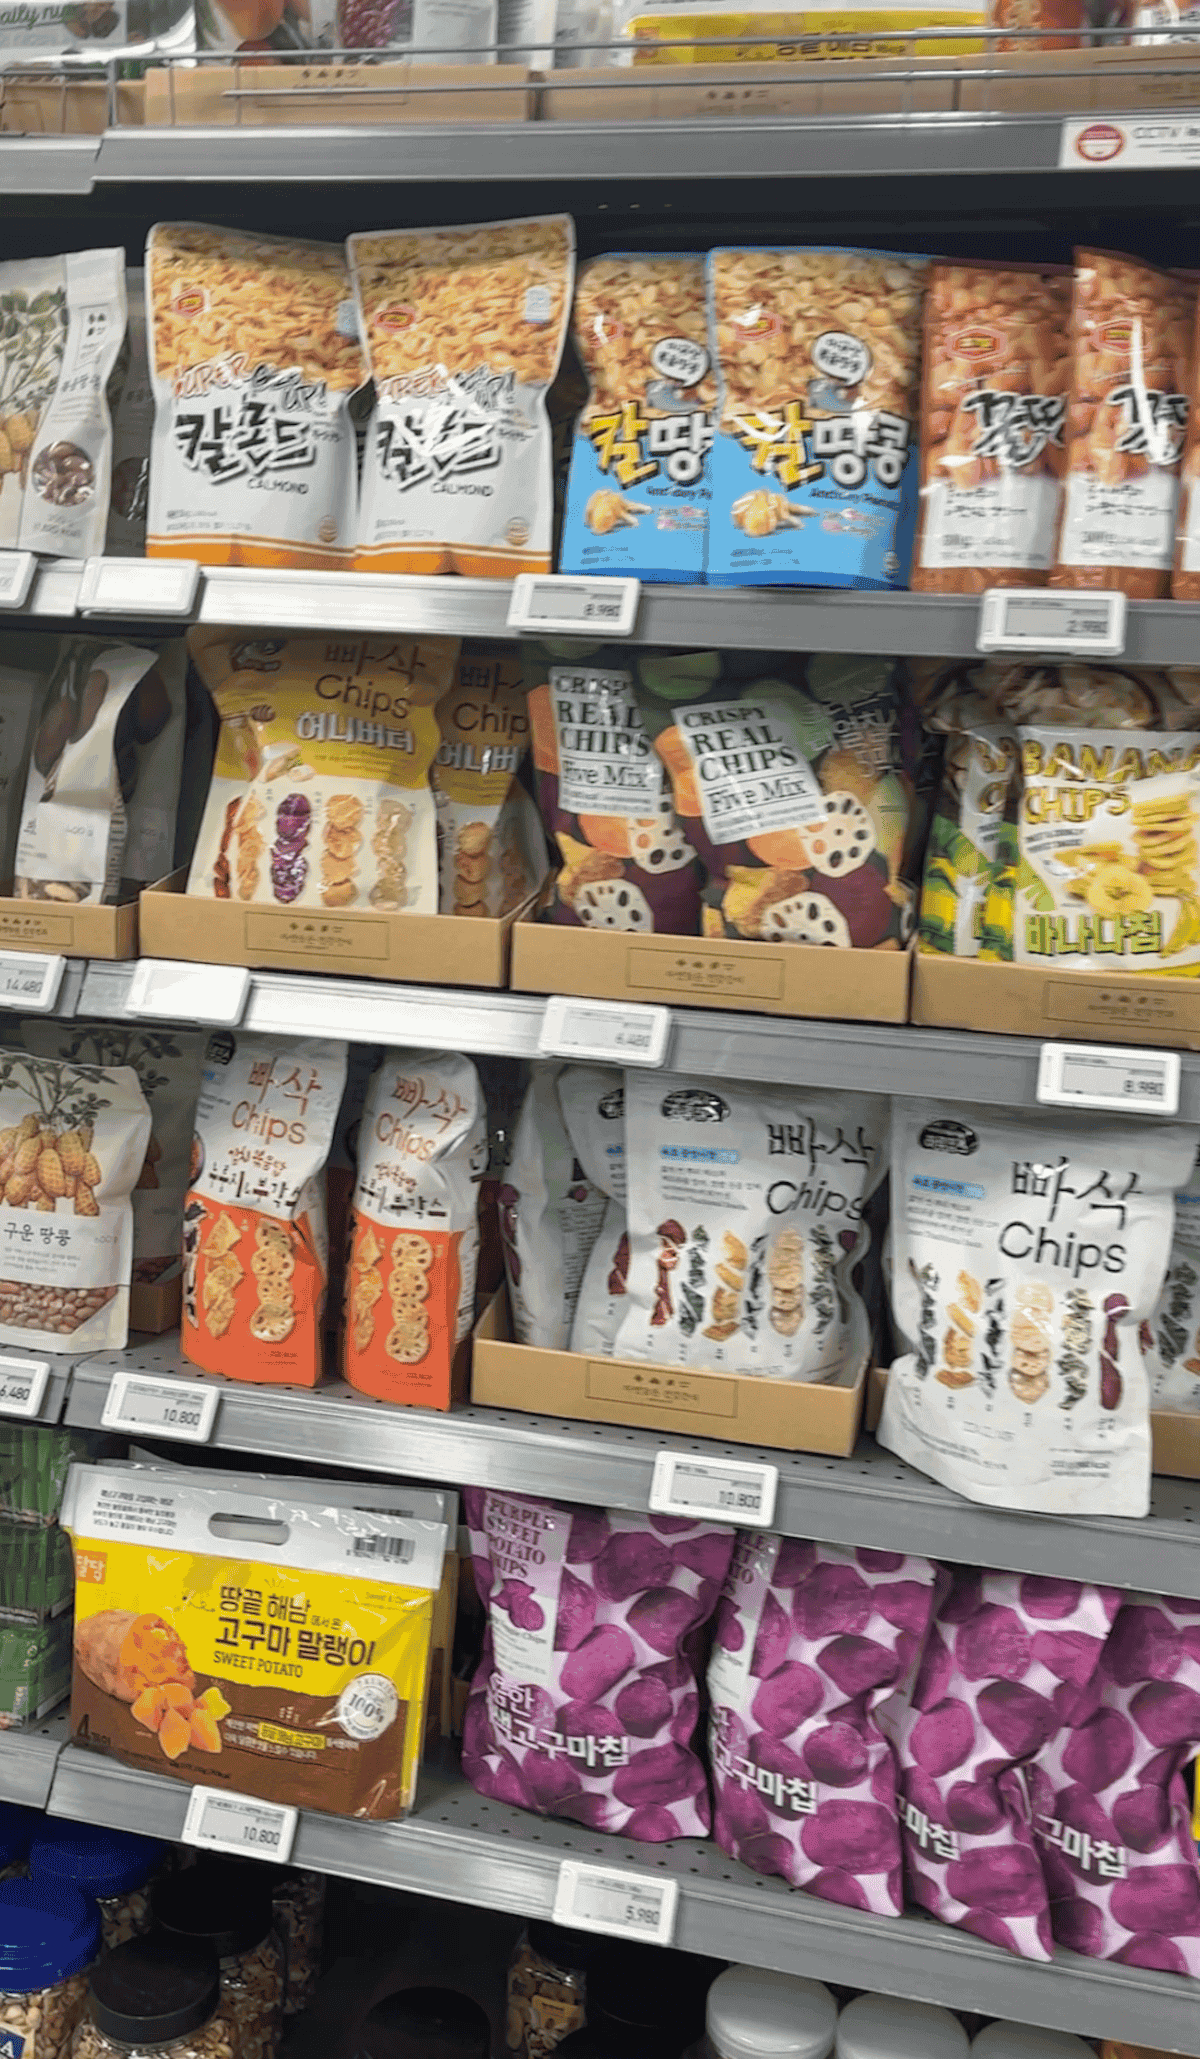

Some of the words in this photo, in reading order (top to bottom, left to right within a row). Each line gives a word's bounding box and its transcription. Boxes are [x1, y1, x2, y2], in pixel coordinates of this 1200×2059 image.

[247, 477, 310, 495] CALMOND
[430, 480, 494, 498] CALMOND
[315, 674, 410, 720] Chips
[555, 675, 630, 698] CRISP
[453, 702, 528, 734] Chip
[557, 700, 646, 730] REAL
[683, 706, 767, 729] CRISPY
[560, 727, 651, 758] CHIPS
[690, 724, 782, 756] REAL
[699, 745, 799, 783] CHIPS
[763, 777, 809, 803] Mix
[1023, 785, 1132, 825] CHIPS
[248, 1056, 323, 1117] 빠삭
[230, 1100, 306, 1146] Chips
[766, 1117, 875, 1176] 빠삭
[766, 1179, 865, 1221] Chips
[1010, 1156, 1144, 1231] 빠삭
[3, 1222, 35, 1243] 구운
[39, 1226, 72, 1247] 땅콩
[999, 1221, 1128, 1279] Chips
[215, 1615, 291, 1657] 고구마
[297, 1629, 377, 1668] 말랭이
[213, 1650, 256, 1671] SWEET
[256, 1657, 304, 1679] POTATO
[348, 1693, 385, 1724] 100%
